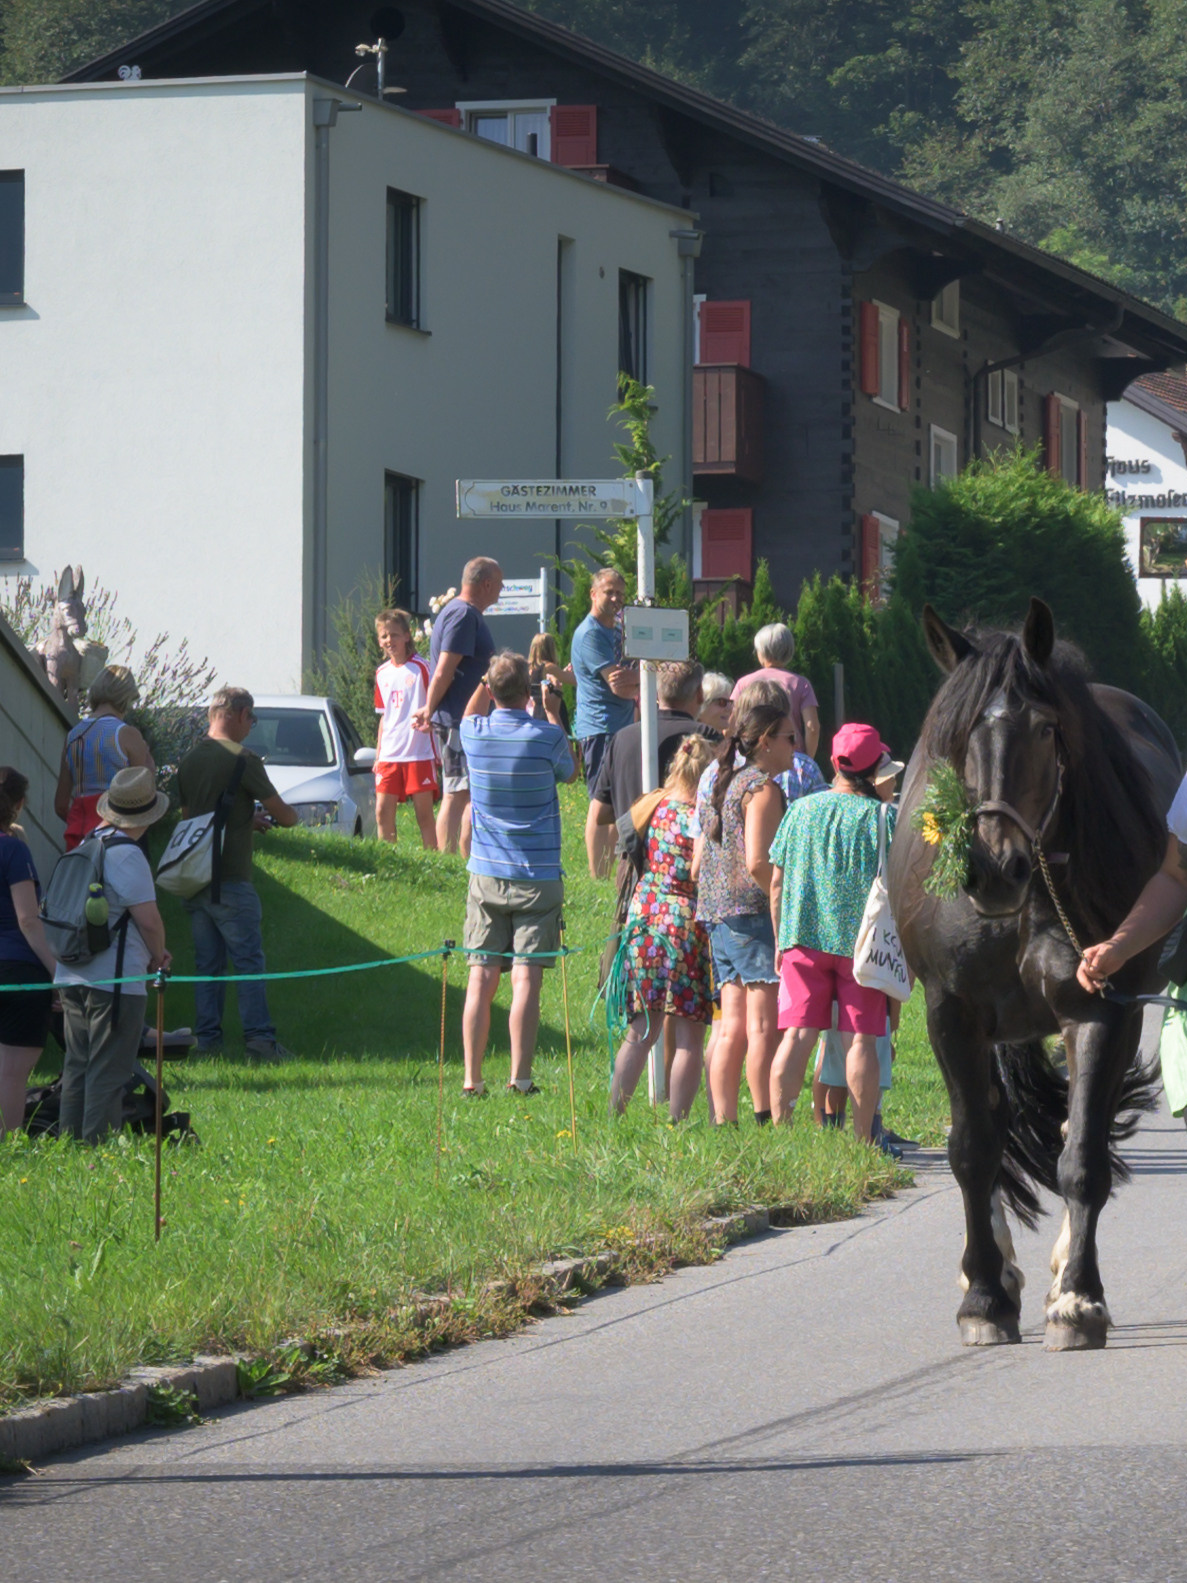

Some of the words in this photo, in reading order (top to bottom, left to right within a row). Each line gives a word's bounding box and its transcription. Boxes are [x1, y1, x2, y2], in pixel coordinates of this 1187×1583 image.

[500, 485, 596, 497] GÄSTEZIMMER
[490, 501, 521, 512] Haus
[578, 501, 597, 512] Nr.
